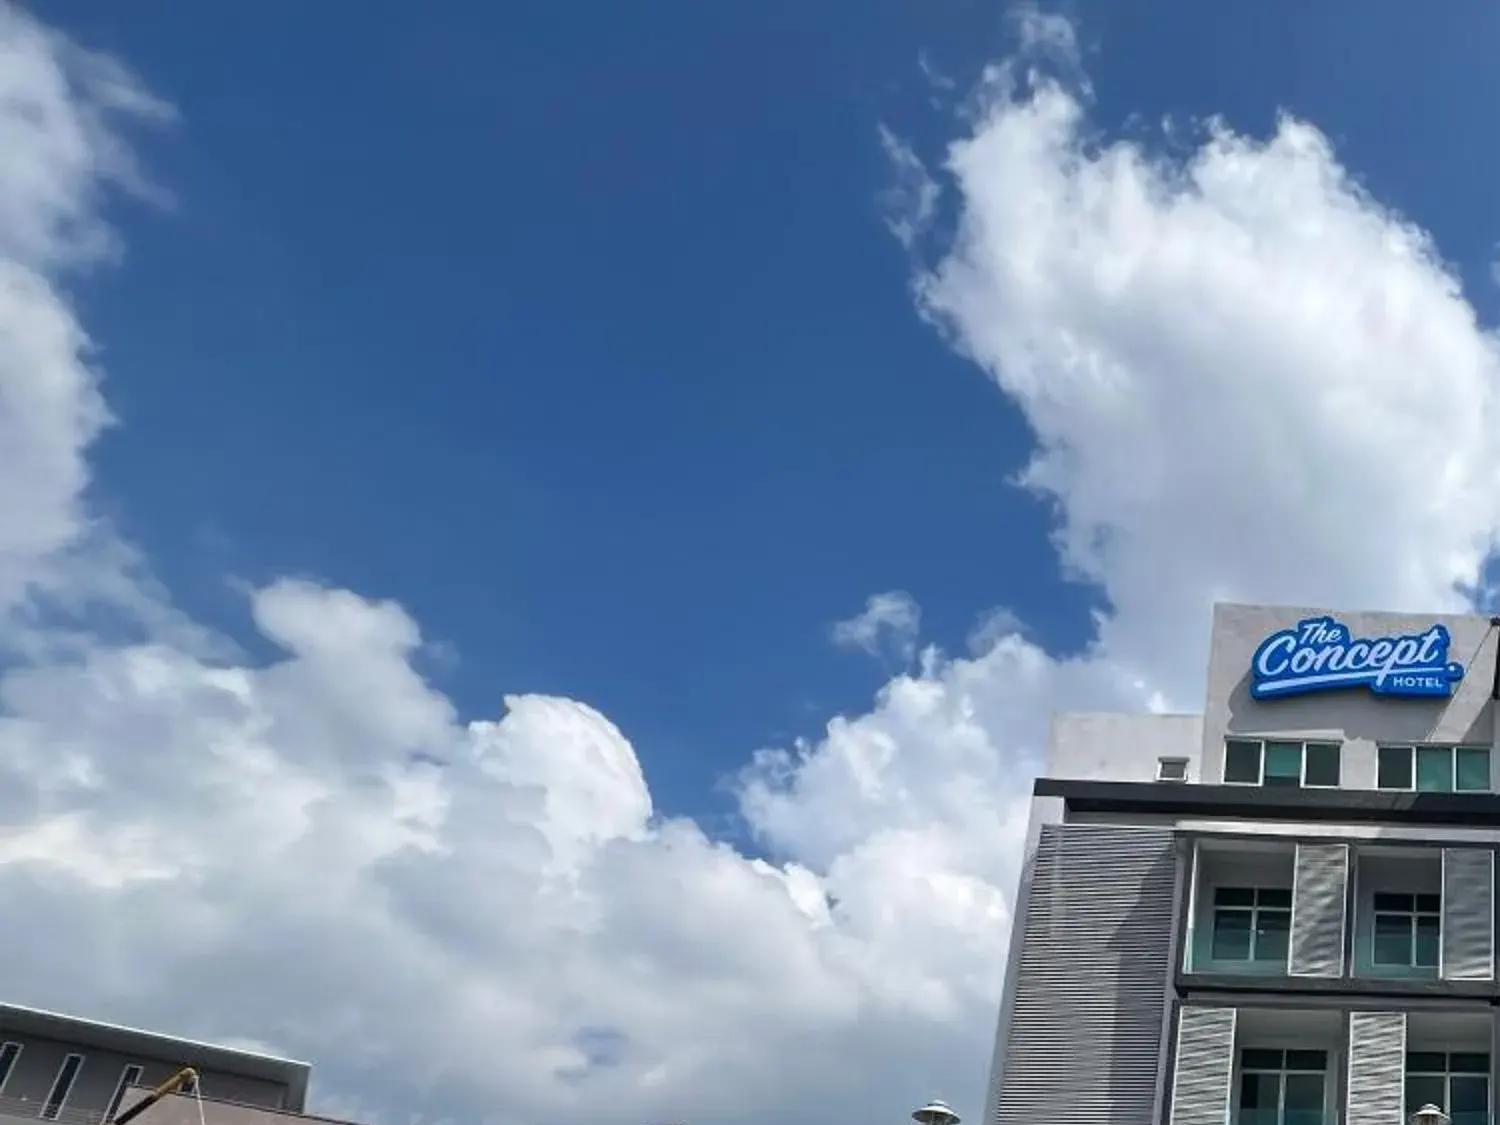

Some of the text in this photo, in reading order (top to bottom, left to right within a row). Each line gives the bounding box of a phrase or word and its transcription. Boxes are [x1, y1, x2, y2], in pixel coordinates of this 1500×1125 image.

[1302, 622, 1342, 644] The
[1258, 628, 1442, 687] Concept
[1392, 675, 1444, 689] HOTEL
